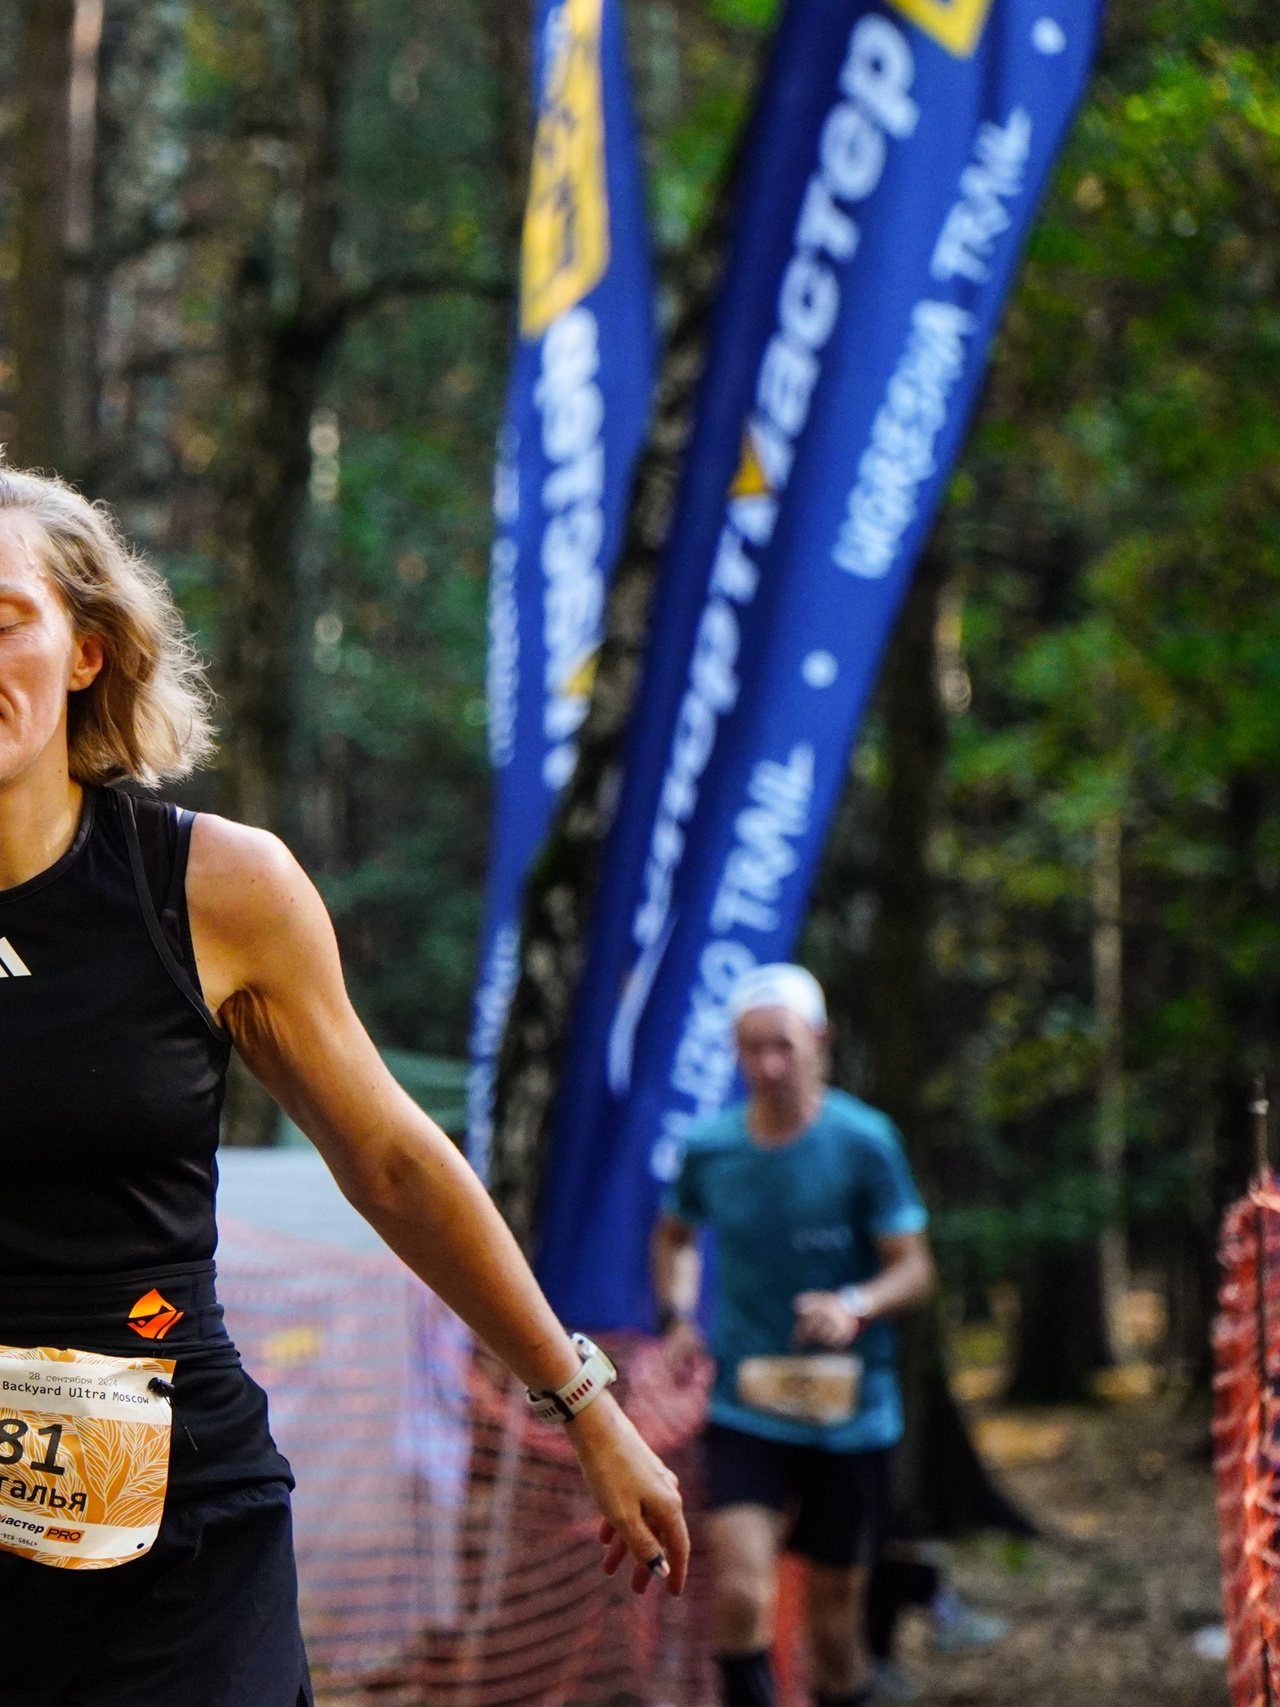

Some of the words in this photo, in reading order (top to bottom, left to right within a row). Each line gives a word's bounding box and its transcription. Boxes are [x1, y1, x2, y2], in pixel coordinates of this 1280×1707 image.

[927, 104, 1034, 286] TRAIL
[708, 738, 818, 934] TRAIL
[28, 1371, 41, 1381] 28
[45, 1374, 93, 1385] сентября
[97, 1377, 118, 1388] 2024
[2, 1380, 62, 1397] Backyard
[68, 1387, 107, 1400] Ultra
[112, 1391, 150, 1405] Moscow
[45, 1527, 83, 1543] PRO
